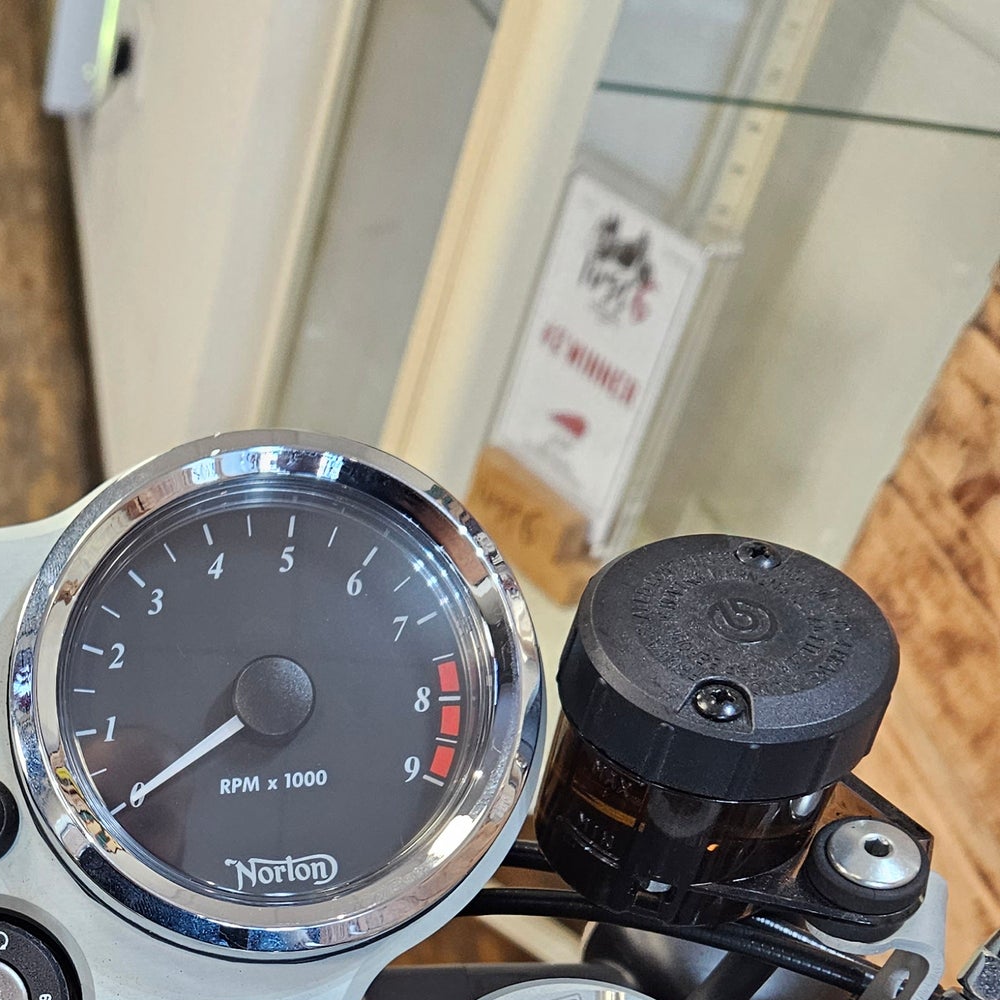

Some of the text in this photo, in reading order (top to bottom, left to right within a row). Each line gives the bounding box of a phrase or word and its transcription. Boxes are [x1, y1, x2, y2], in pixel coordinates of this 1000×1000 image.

[207, 553, 225, 580] 4
[278, 546, 295, 573] 5
[346, 570, 364, 597] 6
[147, 589, 165, 616] 3
[392, 615, 409, 642] 7
[107, 643, 126, 670] 2
[413, 686, 431, 712] 8
[104, 716, 117, 743] 1
[219, 769, 328, 795] RPM x 1000
[403, 755, 421, 783] 9
[224, 853, 338, 891] Norton
